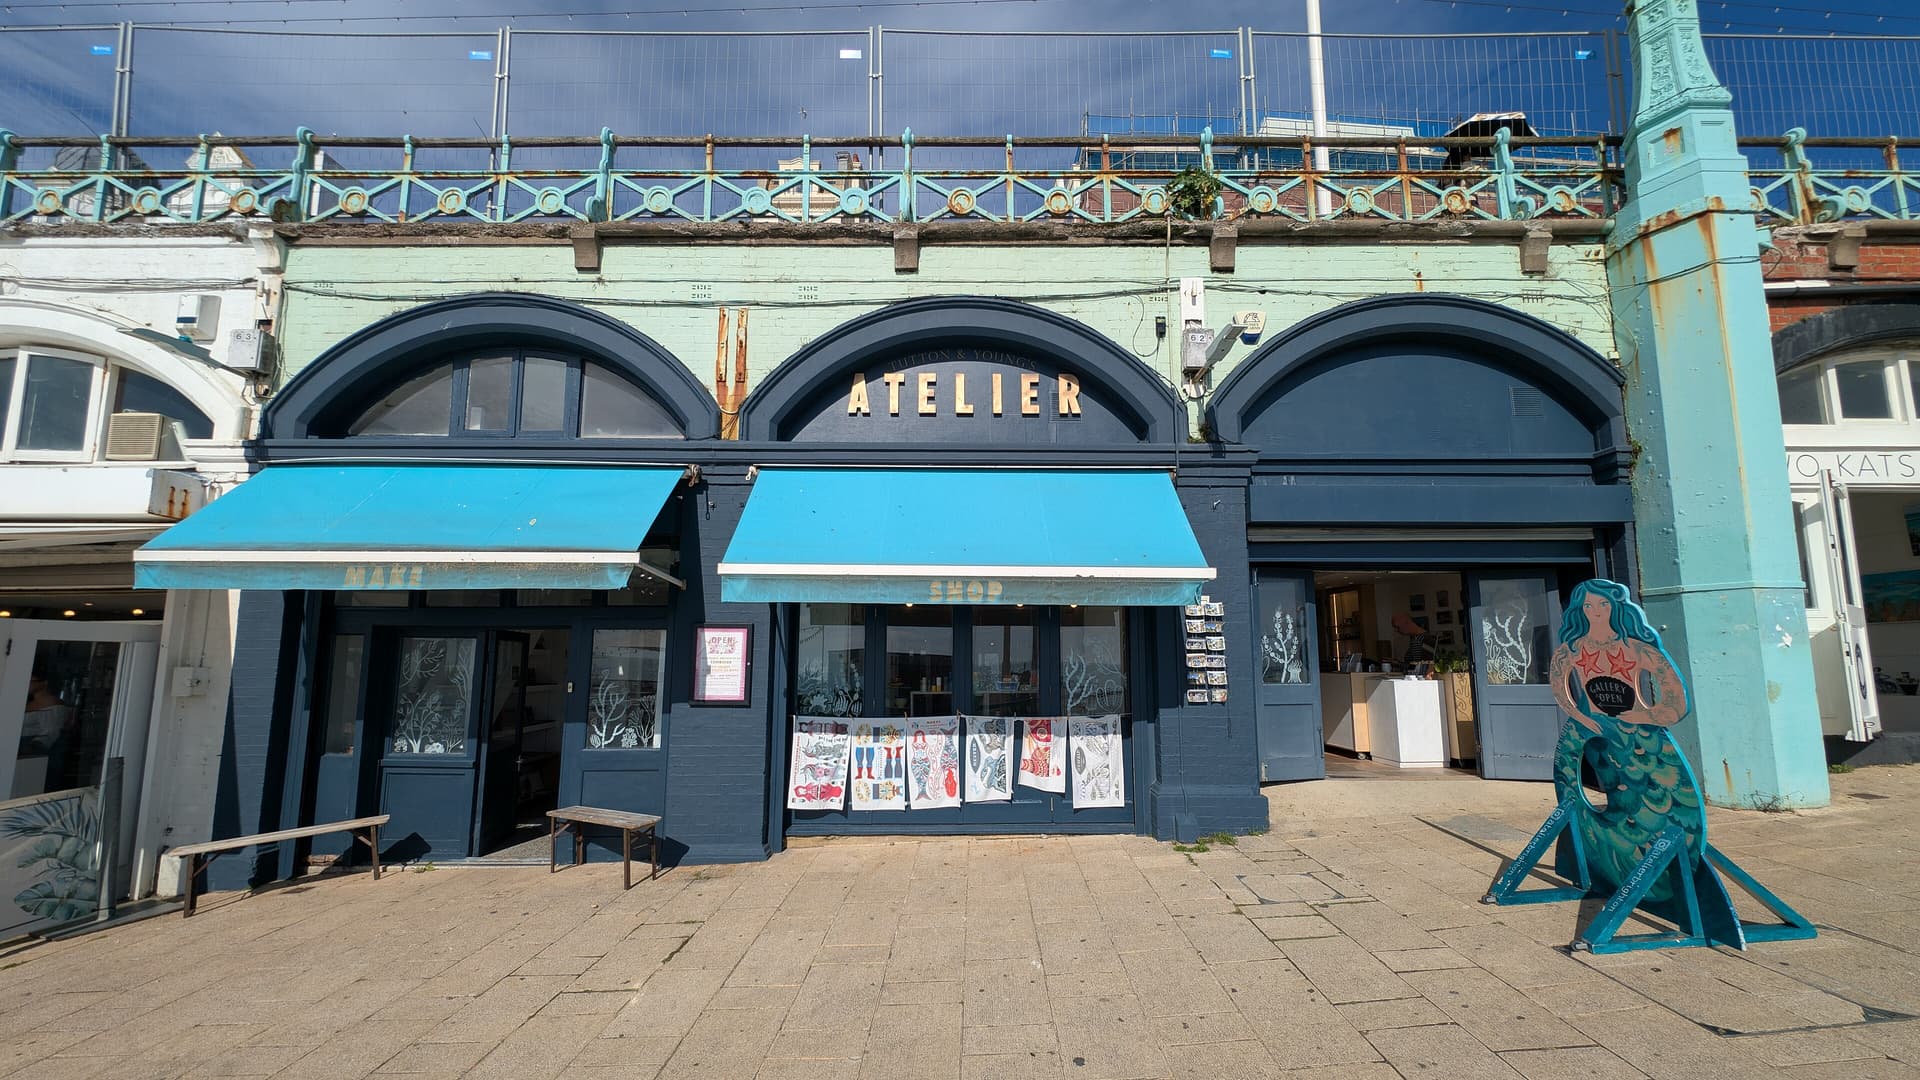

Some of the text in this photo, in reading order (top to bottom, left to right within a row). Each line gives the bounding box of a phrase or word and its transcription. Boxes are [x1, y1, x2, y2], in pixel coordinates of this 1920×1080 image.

[888, 350, 951, 370] TUTTON
[956, 350, 966, 360] &
[847, 373, 1082, 415] ATELIER
[1786, 454, 1916, 477] O KATS
[344, 566, 423, 586] MAKE
[930, 580, 1003, 601] SHOP
[711, 636, 733, 645] OPEN
[1590, 682, 1627, 695] GALLERY
[1599, 694, 1623, 703] OPEN
[1607, 846, 1663, 913] atelierbrighton
